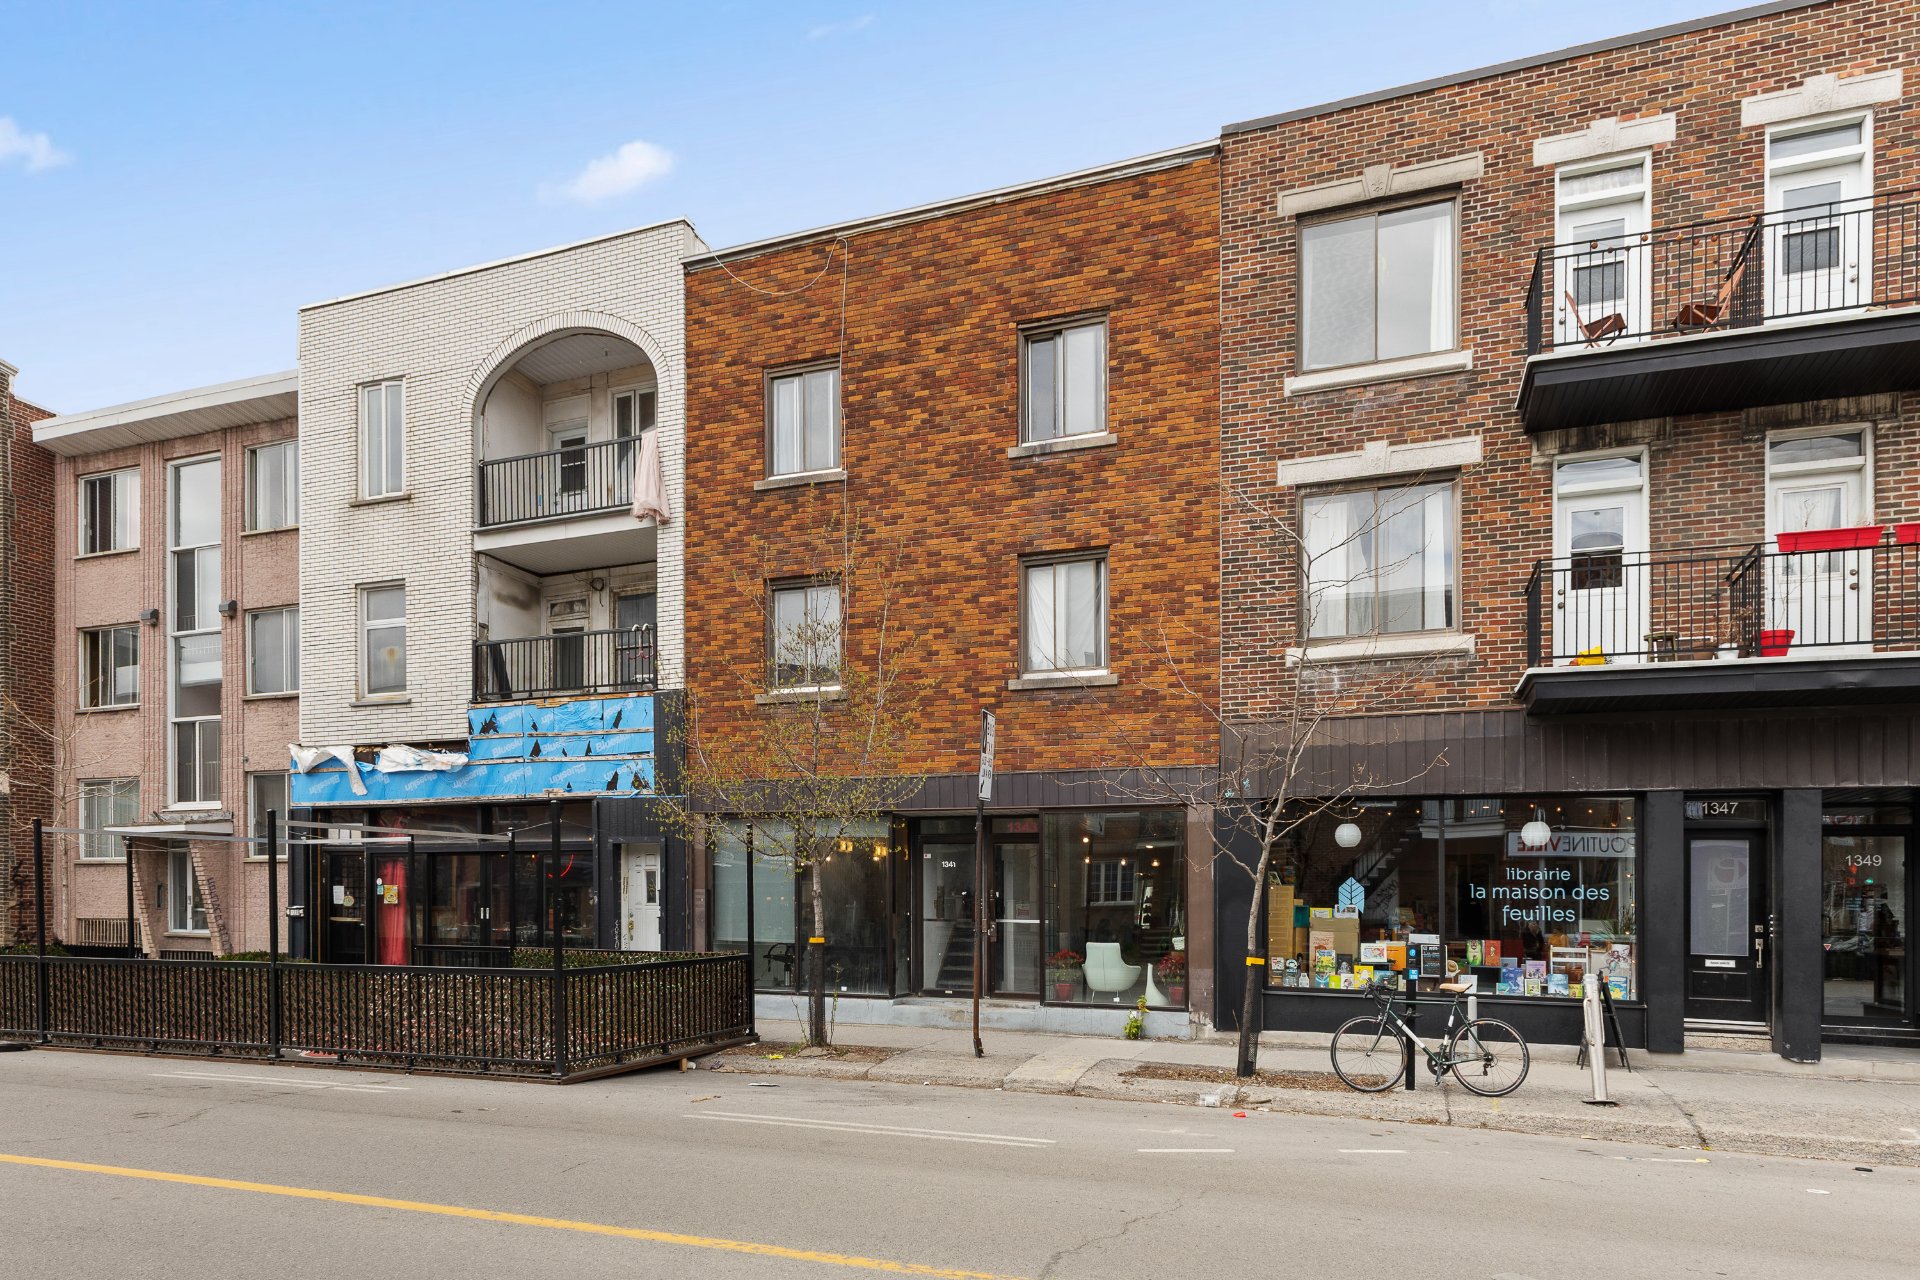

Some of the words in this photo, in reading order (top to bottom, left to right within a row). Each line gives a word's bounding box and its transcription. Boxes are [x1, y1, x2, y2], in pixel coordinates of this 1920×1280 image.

[1701, 802, 1738, 815] 1347
[1845, 854, 1882, 867] 1349
[1505, 867, 1571, 881] librairie
[1469, 883, 1486, 900] la
[1492, 884, 1566, 900] maison
[1571, 884, 1610, 901] des
[1502, 905, 1576, 927] feuilles
